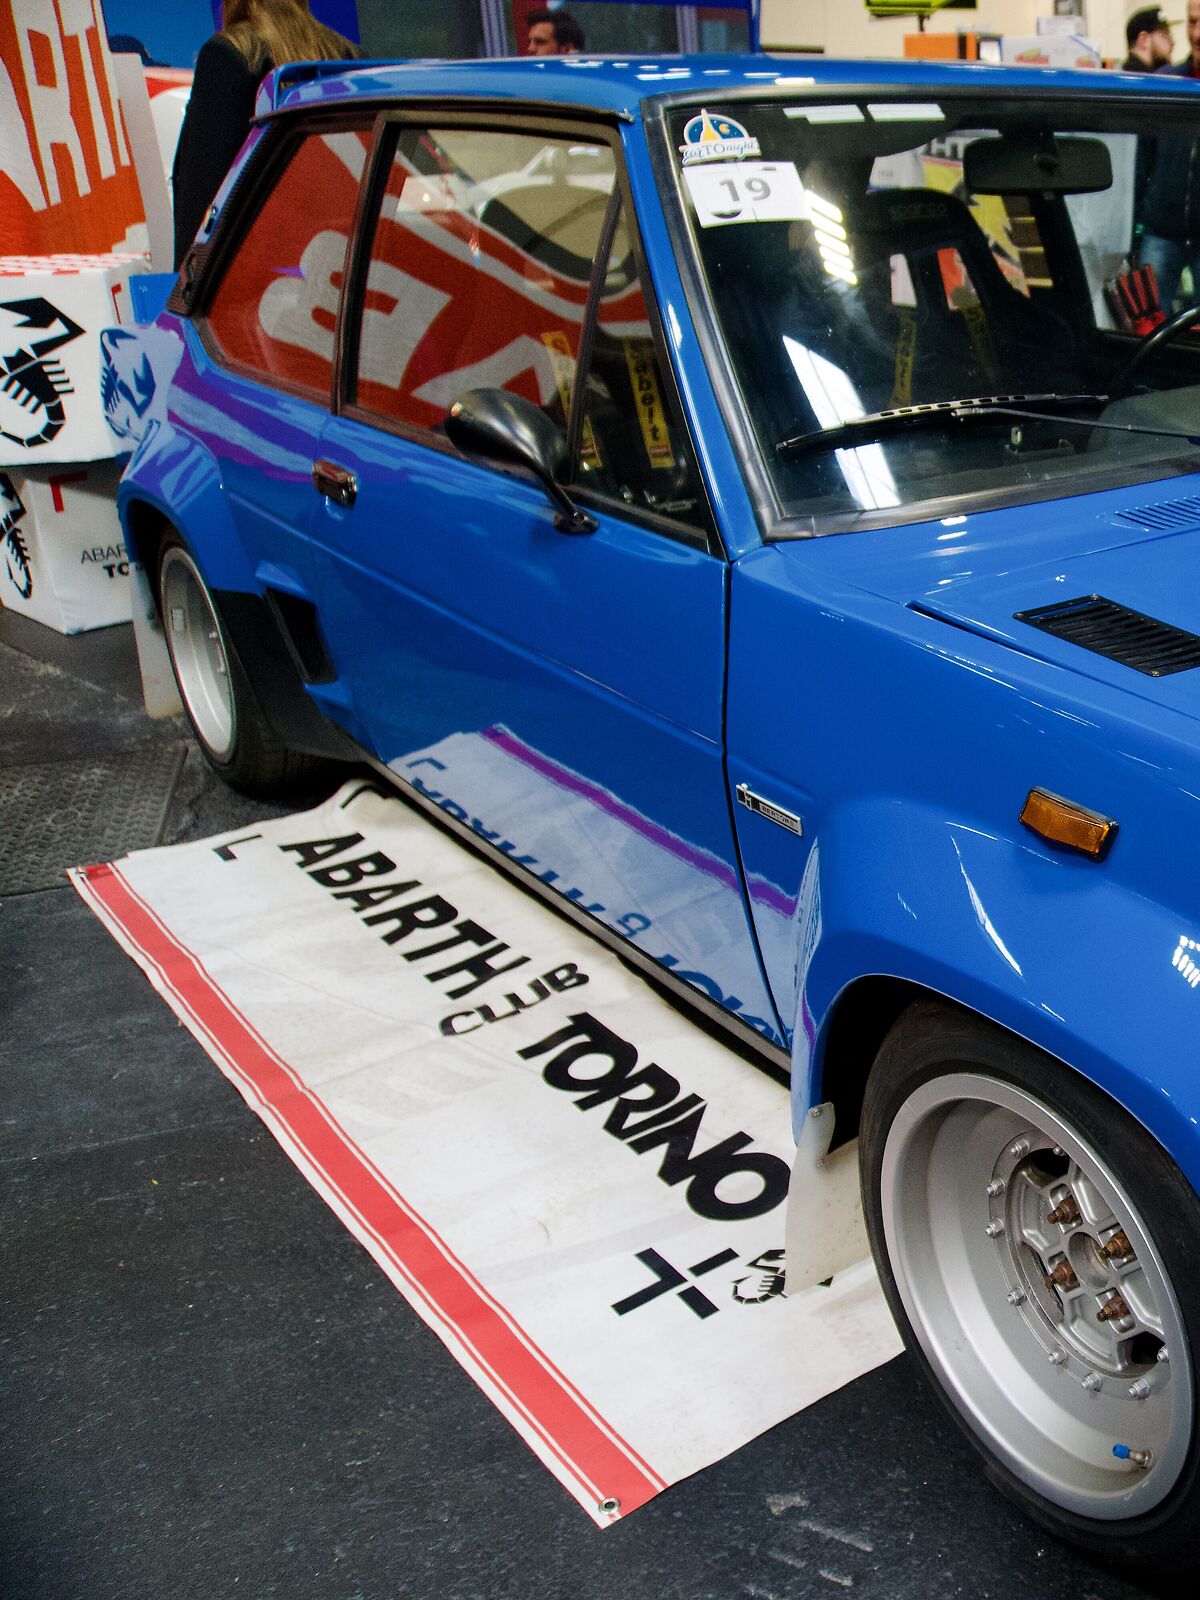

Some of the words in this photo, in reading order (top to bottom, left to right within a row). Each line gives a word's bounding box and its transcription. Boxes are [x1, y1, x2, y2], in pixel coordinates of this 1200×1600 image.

[719, 177, 770, 202] 19
[278, 832, 532, 1000] ABARTH
[439, 963, 590, 1037] CLUB
[516, 1012, 791, 1222] TORINO
